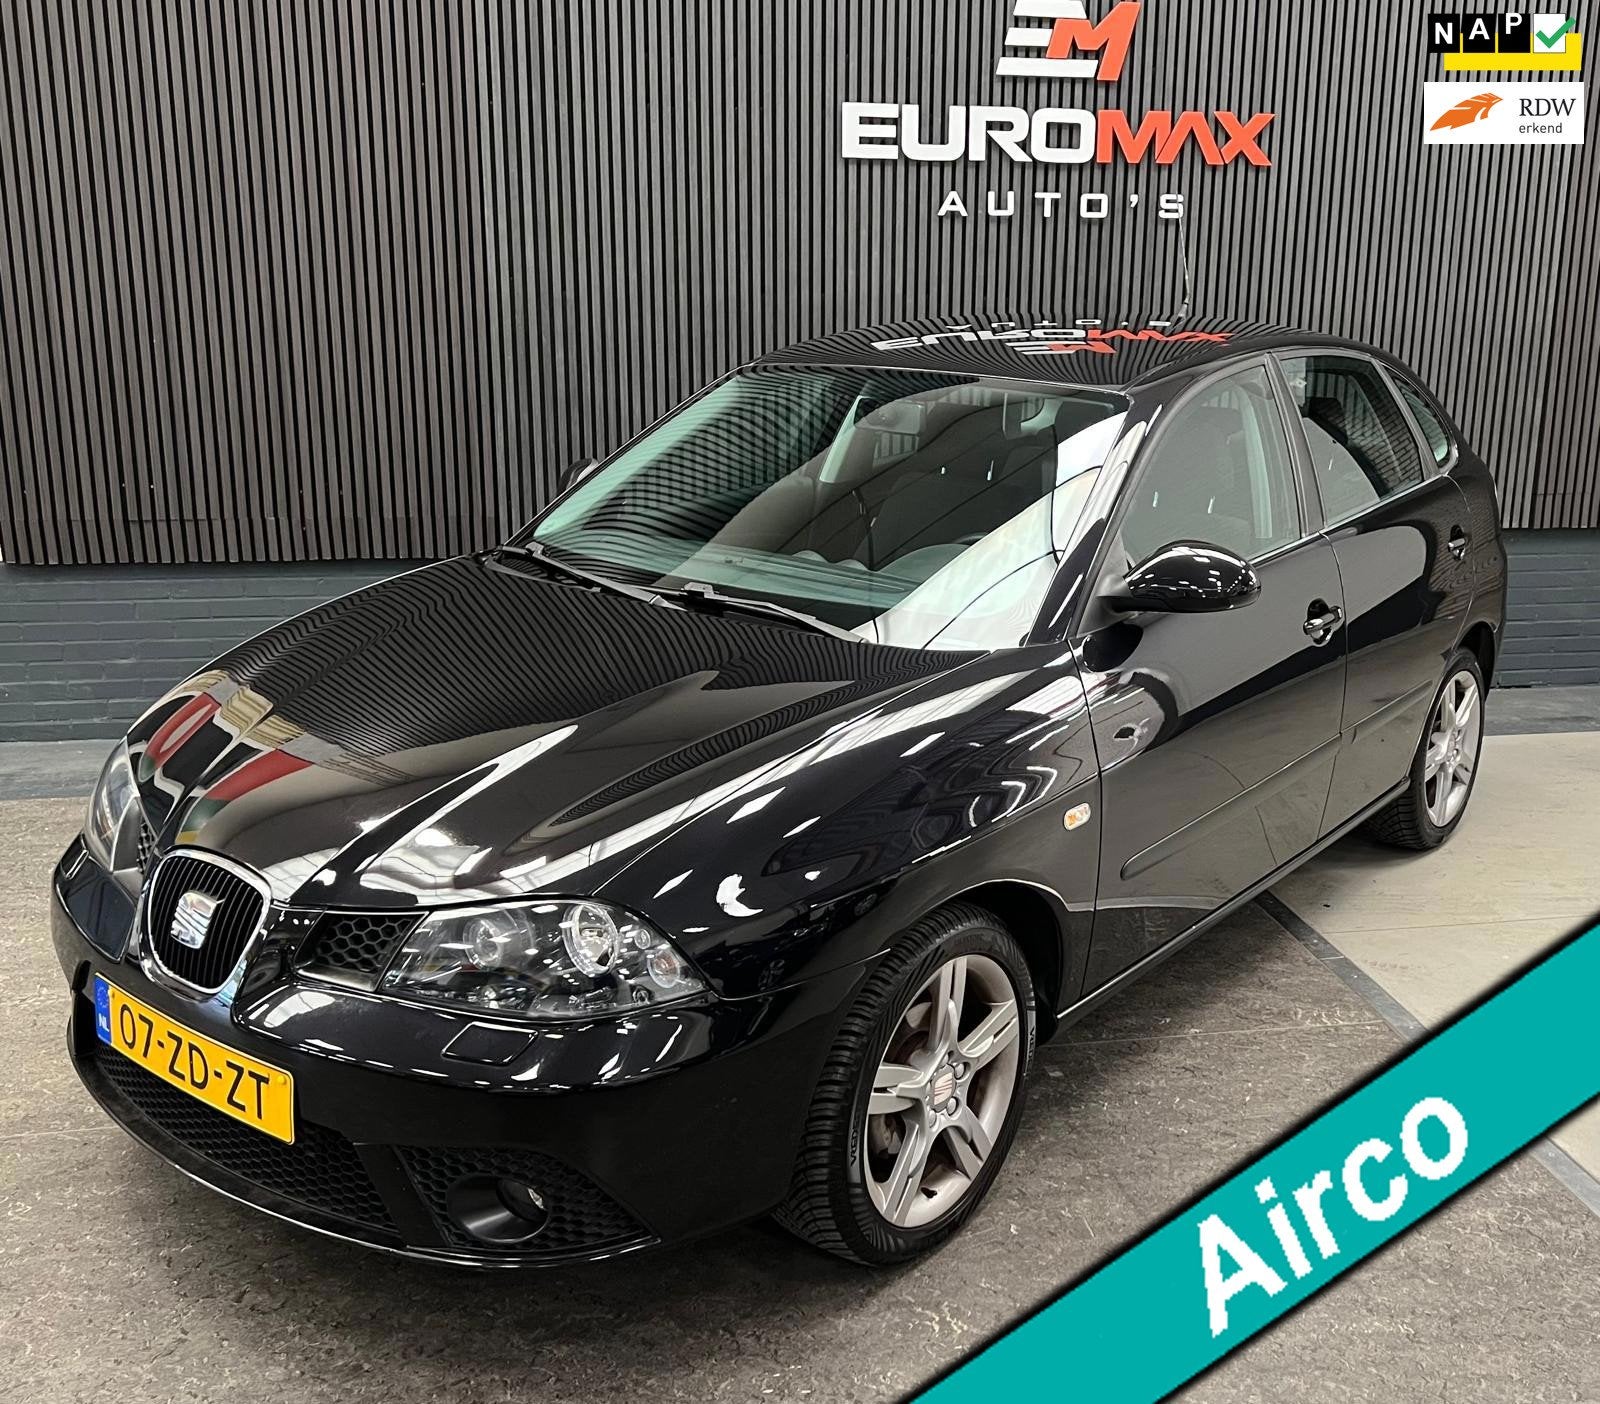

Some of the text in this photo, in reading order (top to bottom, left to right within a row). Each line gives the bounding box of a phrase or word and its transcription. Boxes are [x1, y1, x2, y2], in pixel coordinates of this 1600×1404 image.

[841, 101, 1277, 167] EUROMAX
[936, 190, 1186, 220] AUTO'S
[119, 1003, 270, 1121] 07-ZD-ZT
